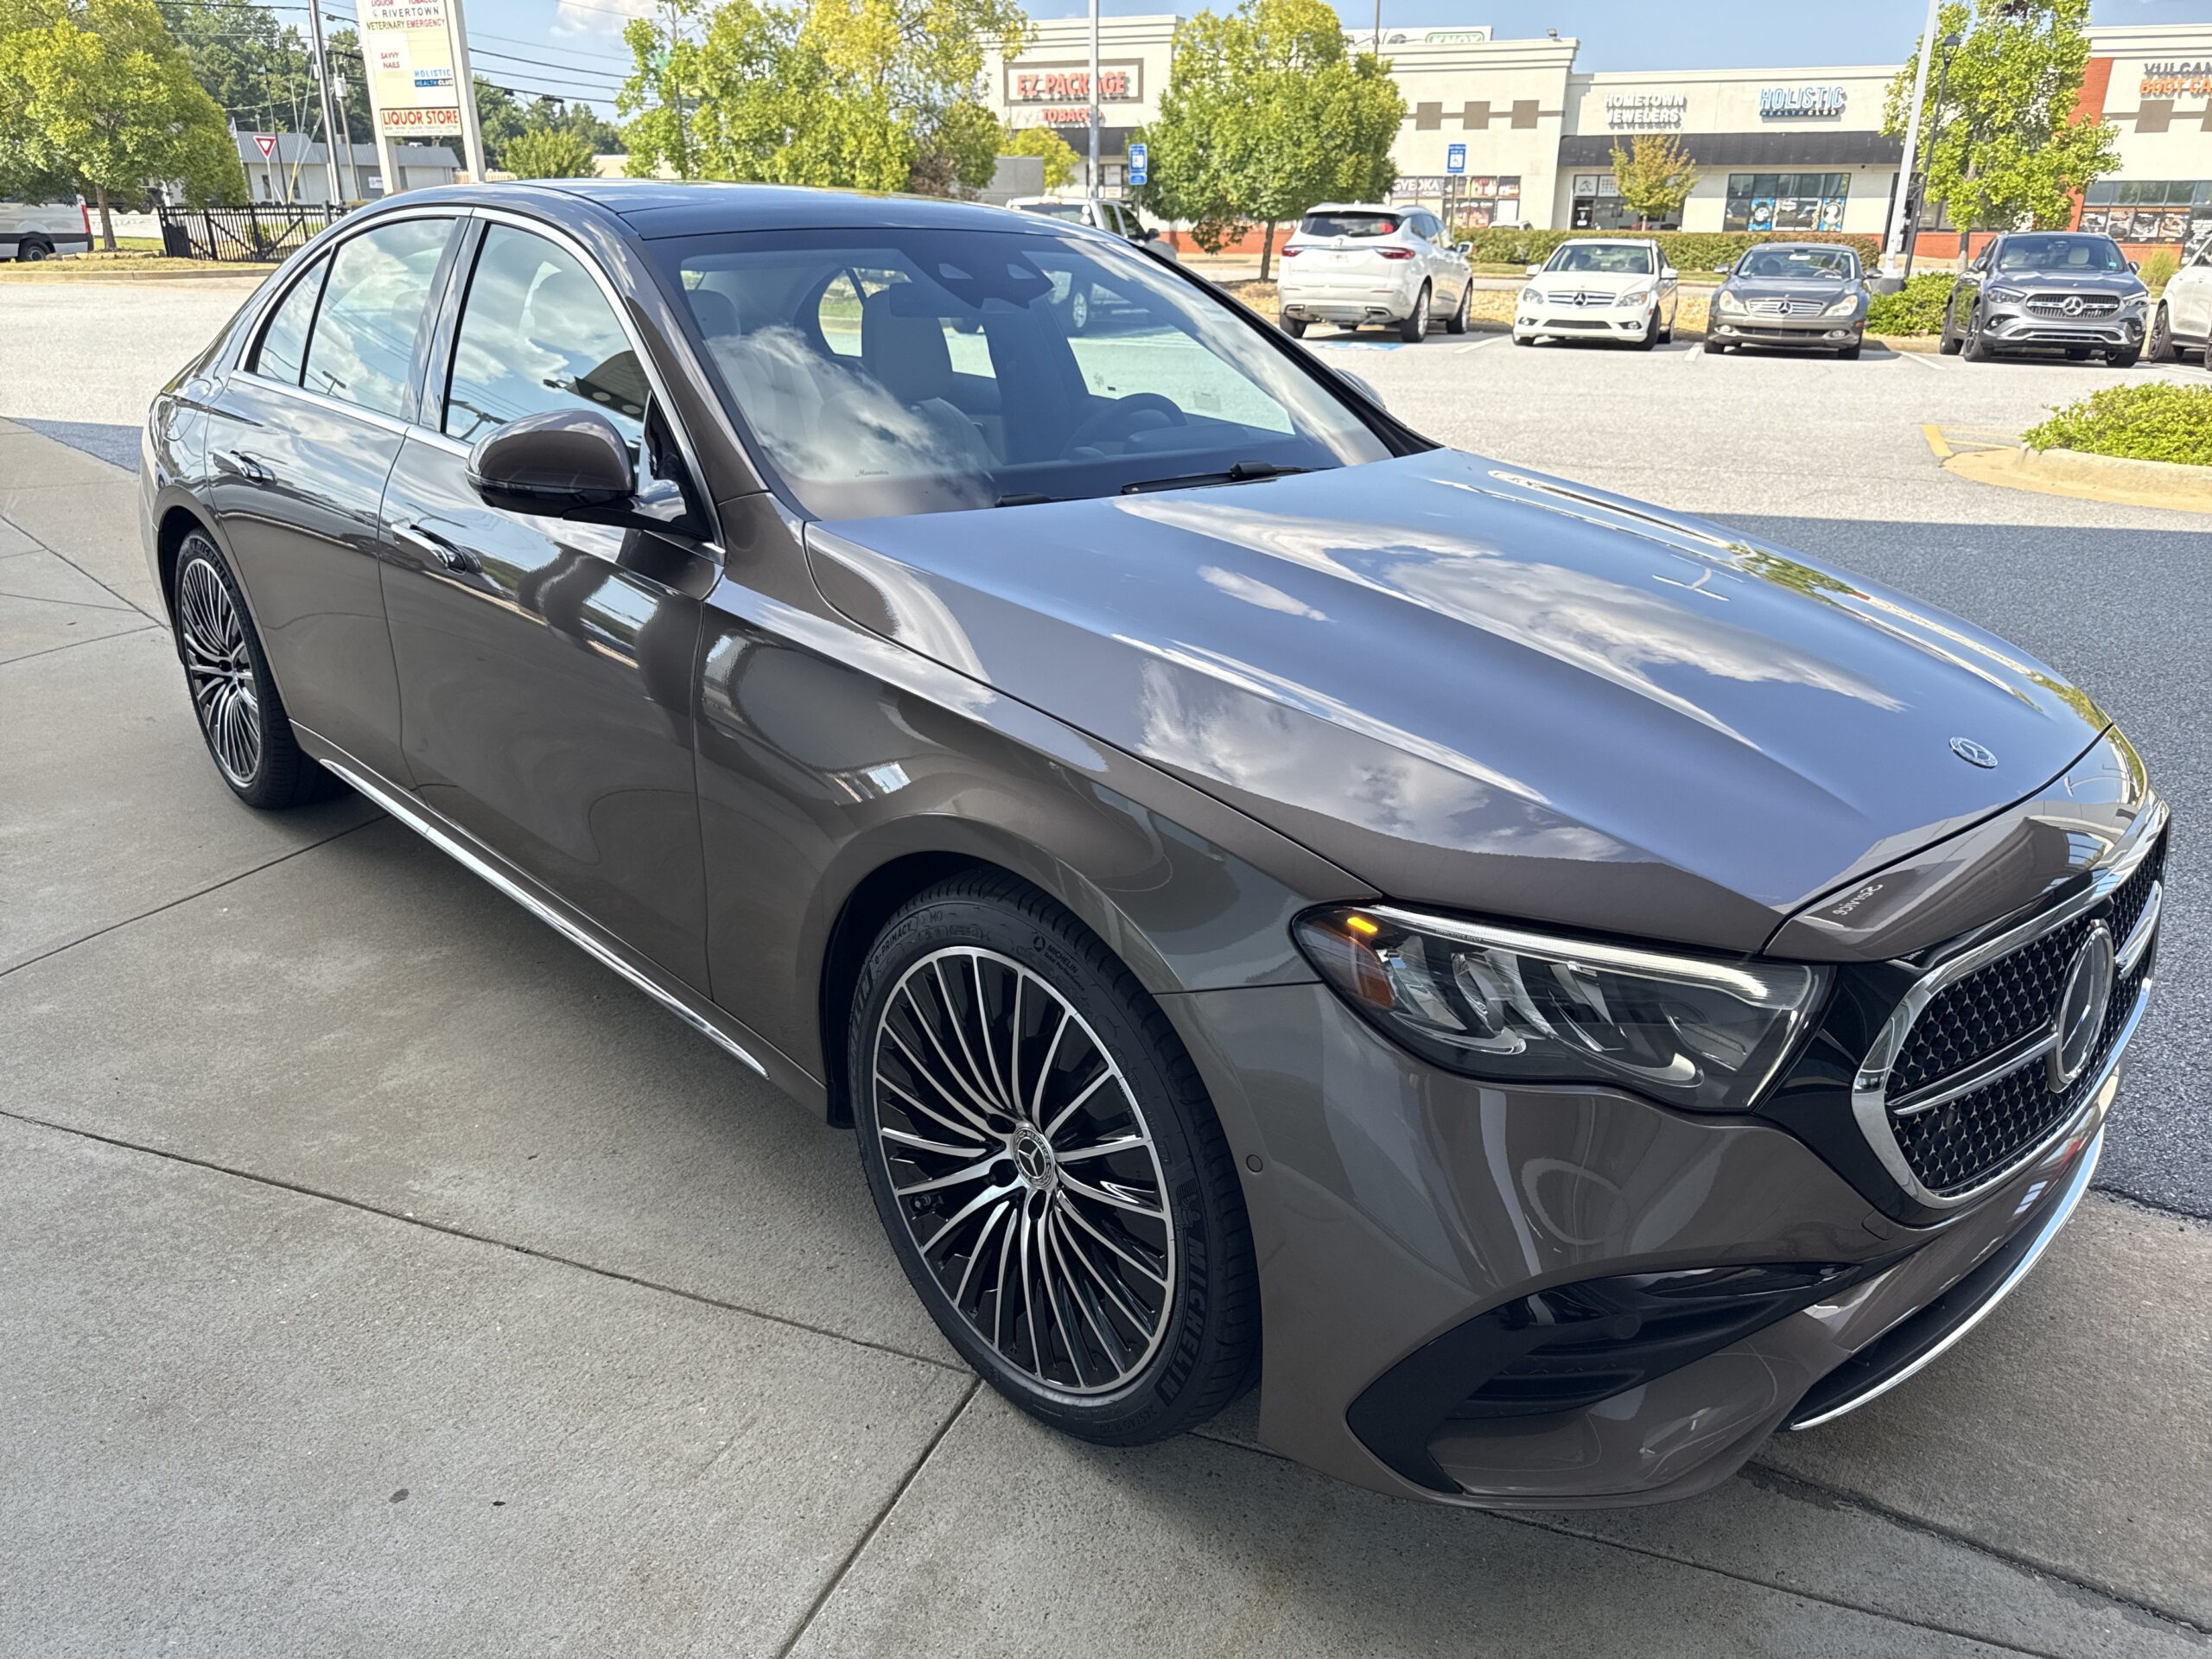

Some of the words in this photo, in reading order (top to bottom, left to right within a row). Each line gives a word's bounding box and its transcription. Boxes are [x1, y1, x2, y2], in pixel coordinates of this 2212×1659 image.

[382, 6, 439, 17] RIVERTOWN
[366, 21, 404, 30] VETERINARY
[406, 18, 445, 29] EMERGENCY
[415, 69, 451, 78] HOLISTIC
[1017, 73, 1039, 96] EZ
[1044, 71, 1126, 95] PACKGE
[2139, 77, 2186, 93] BOOT
[2189, 76, 2212, 93] CA
[1604, 93, 1685, 107] HOMETOWN
[1759, 86, 1845, 110] HOLISTIC
[382, 111, 423, 125] LIQUOR
[426, 110, 459, 124] STORE
[1041, 108, 1103, 122] TOBACC
[1607, 106, 1680, 123] JEWELERS
[1047, 944, 1078, 974] MICHELIN
[1160, 1236, 1207, 1402] MICHELIN
